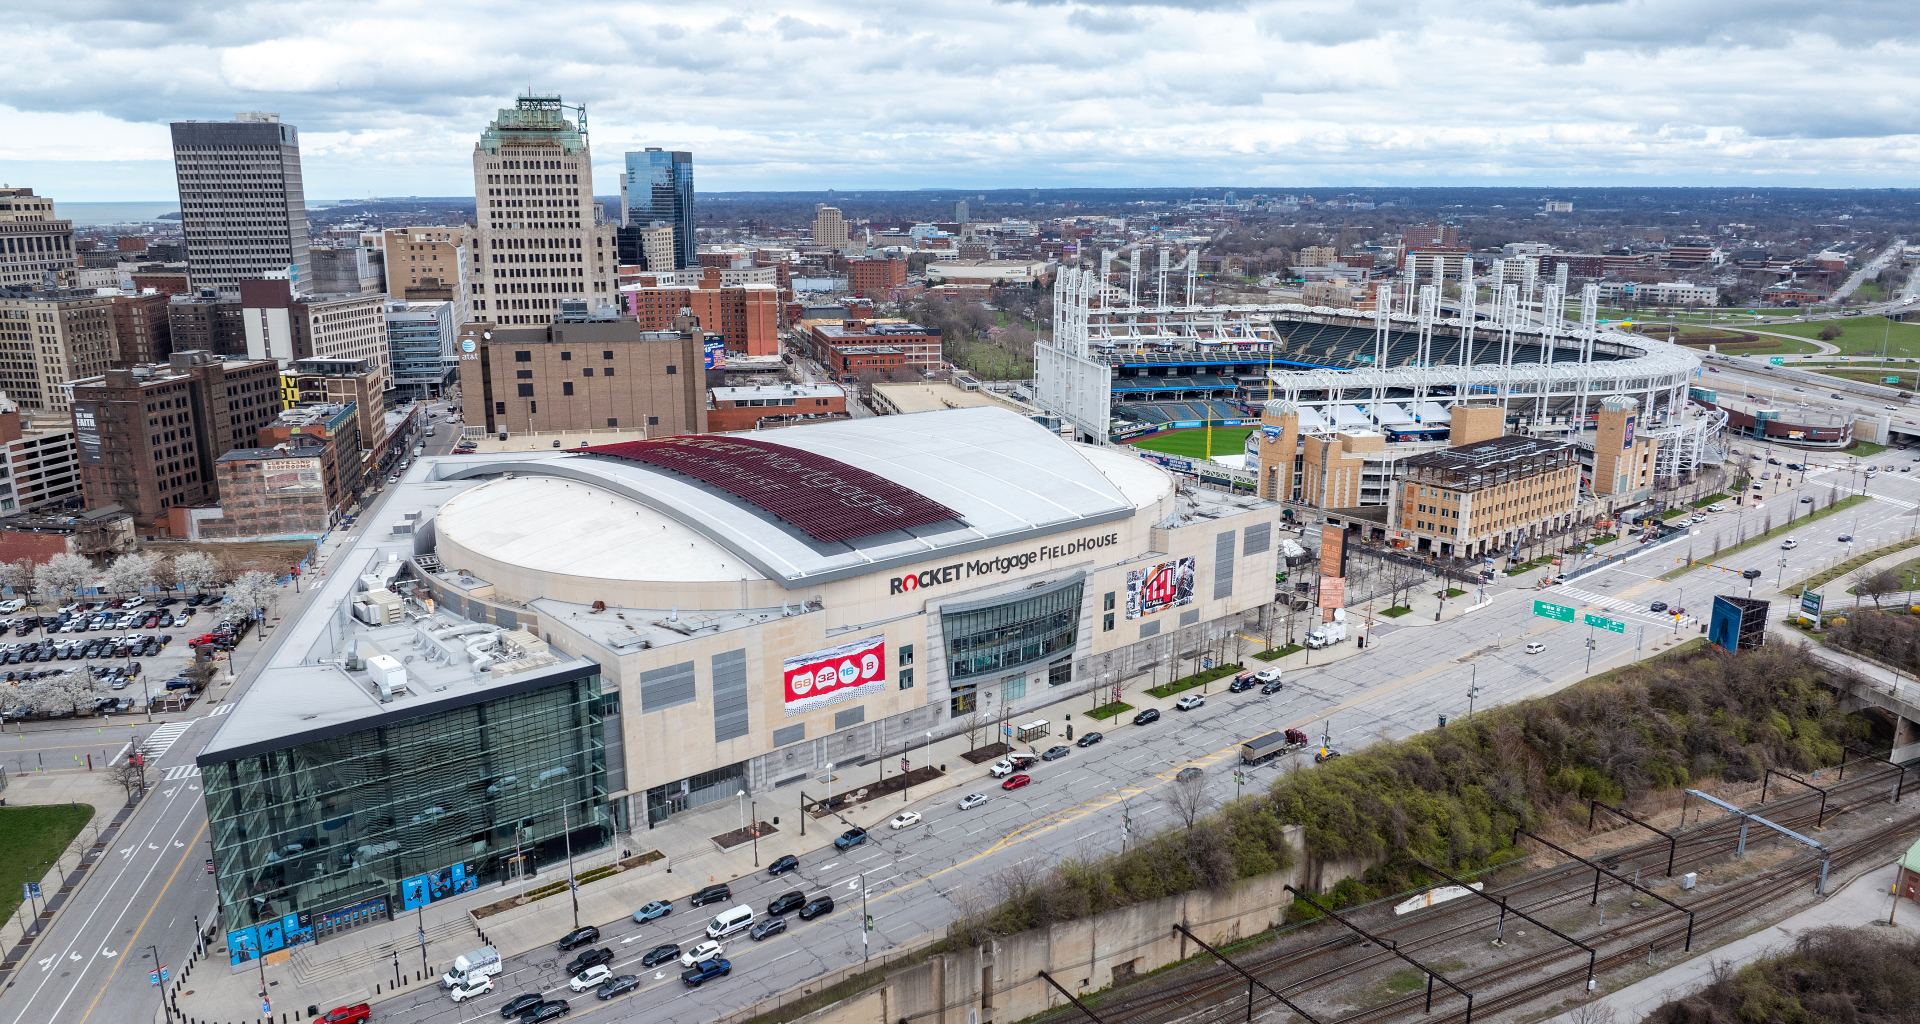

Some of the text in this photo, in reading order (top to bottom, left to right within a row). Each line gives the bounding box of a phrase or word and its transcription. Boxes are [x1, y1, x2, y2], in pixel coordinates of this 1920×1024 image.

[890, 563, 964, 595] ROCKET
[966, 550, 1037, 578] Mortgage
[794, 662, 874, 690] 68 32 16 8
